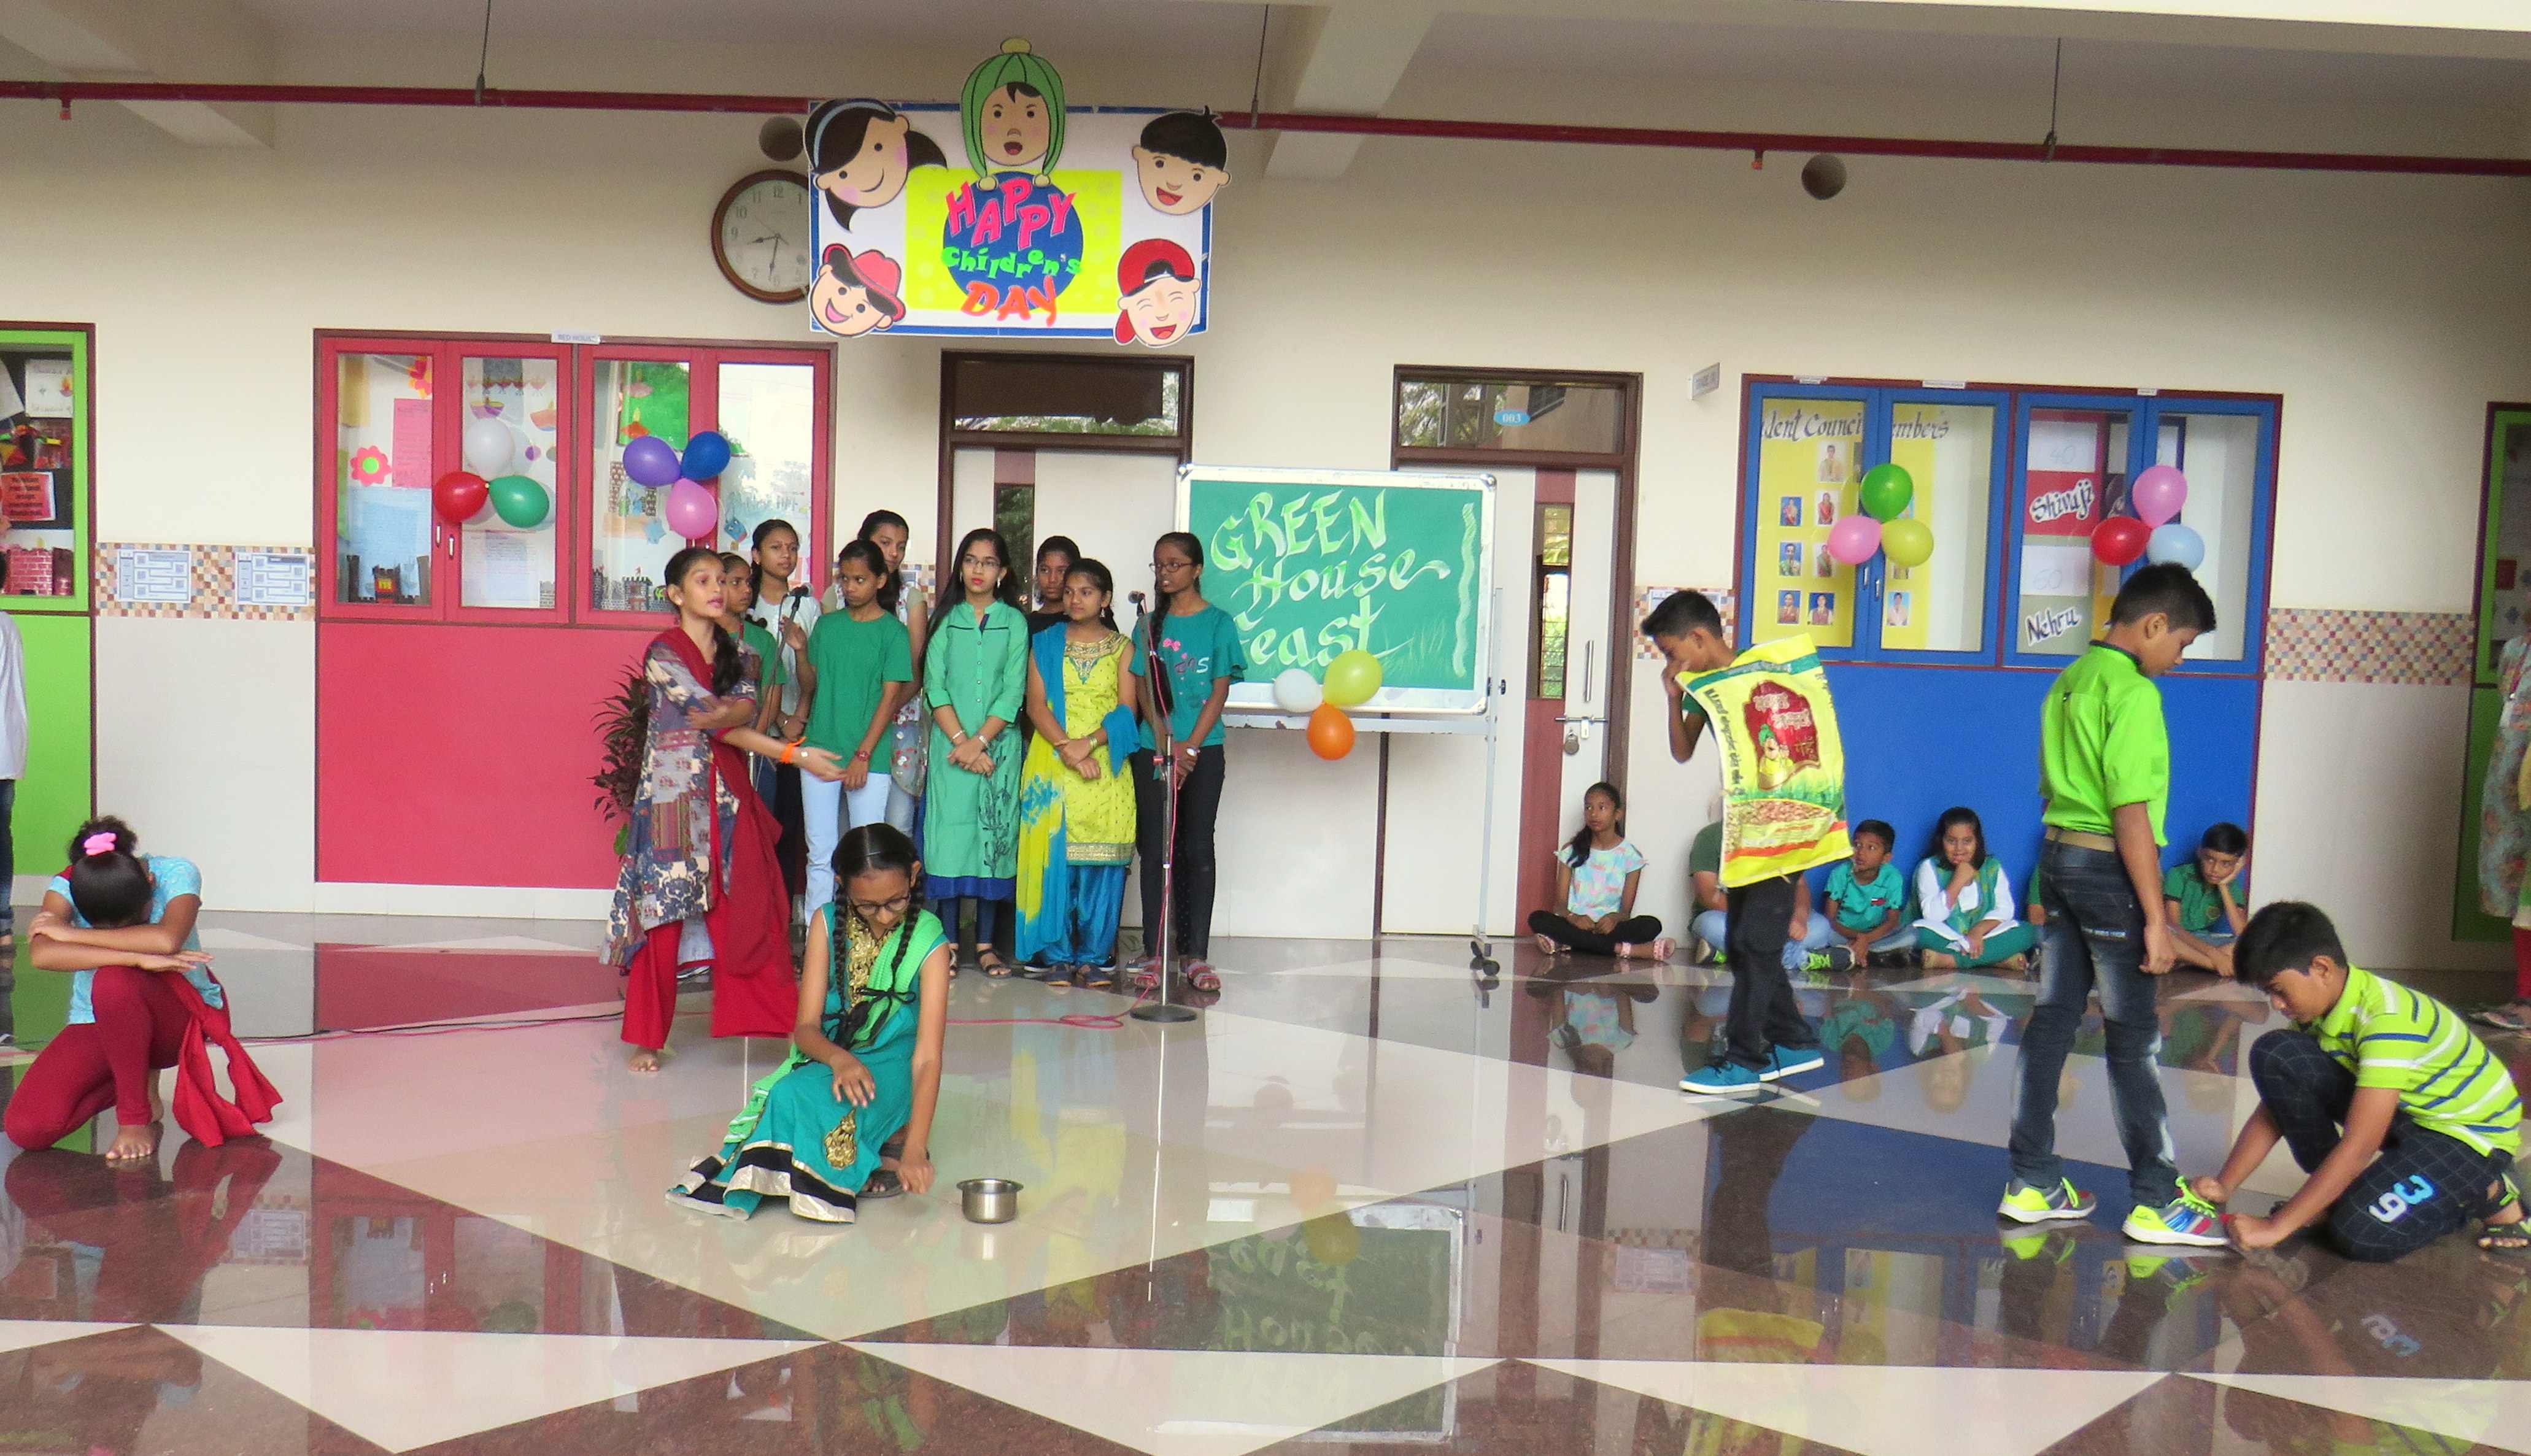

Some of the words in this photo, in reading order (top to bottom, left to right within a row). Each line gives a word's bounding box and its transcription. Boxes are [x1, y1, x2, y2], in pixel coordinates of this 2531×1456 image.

[946, 177, 1076, 249] HAPPY
[941, 245, 1084, 279] Children's
[960, 275, 1057, 327] DAY
[1762, 408, 1799, 441] dent
[2031, 480, 2092, 520] Shivaji
[1211, 489, 1386, 571] GREEN
[1231, 549, 1450, 615] House
[2027, 609, 2079, 643] Nehru
[2368, 1174, 2435, 1223] 93
